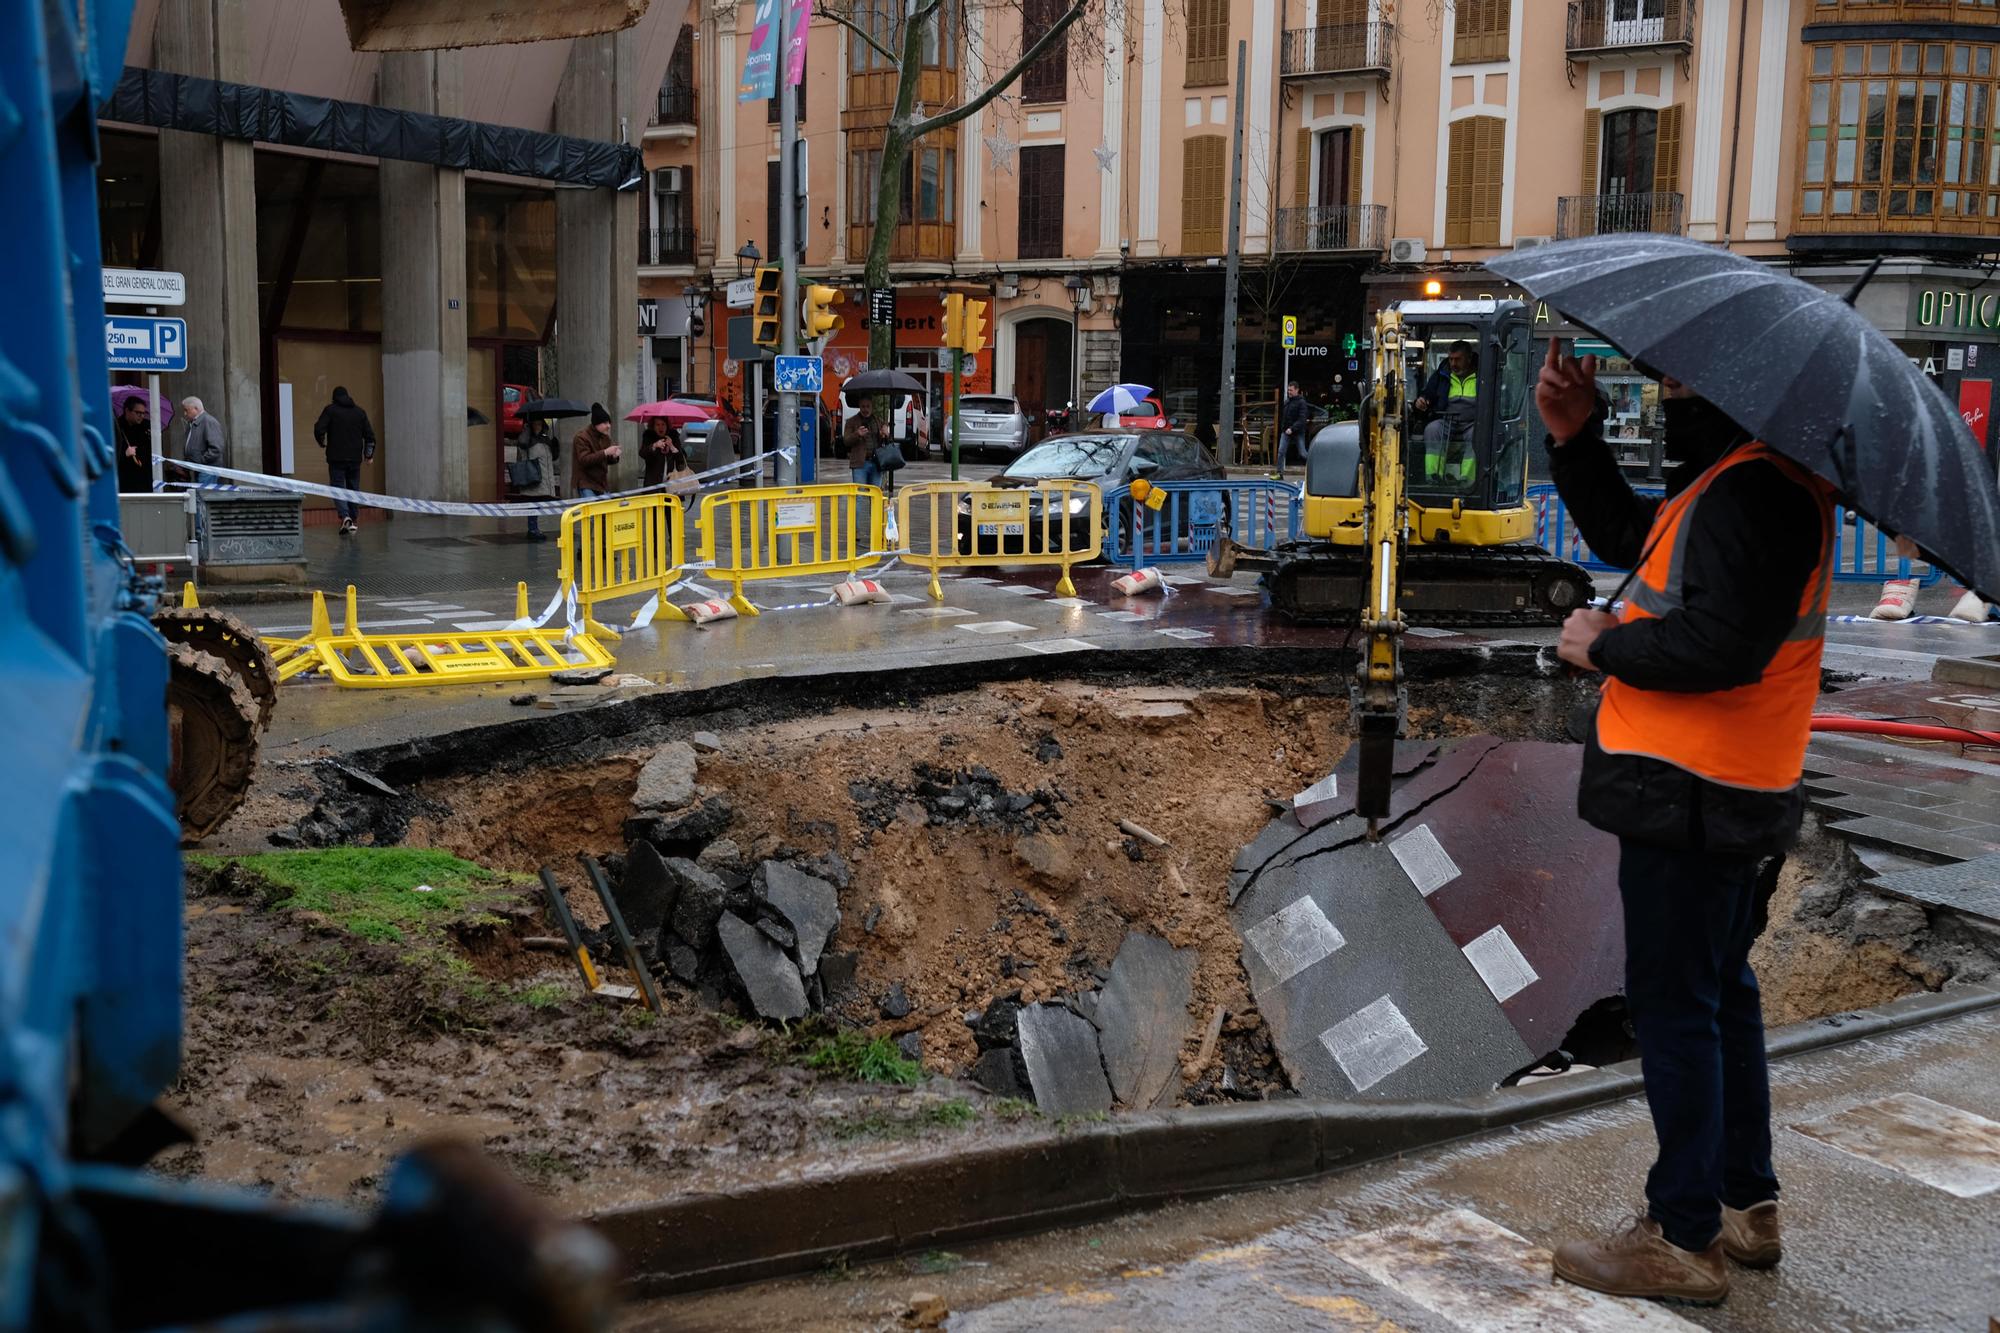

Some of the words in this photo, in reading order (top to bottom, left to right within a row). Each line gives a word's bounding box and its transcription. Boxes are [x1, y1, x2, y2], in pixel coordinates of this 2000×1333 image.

[115, 276, 132, 289] GRAN
[132, 277, 157, 290] GENERAL
[157, 279, 181, 291] CONSELL
[639, 304, 658, 327] NT
[108, 333, 125, 344] 250
[128, 336, 137, 344] m
[158, 326, 177, 353] P
[147, 356, 169, 365] ESPAÑA
